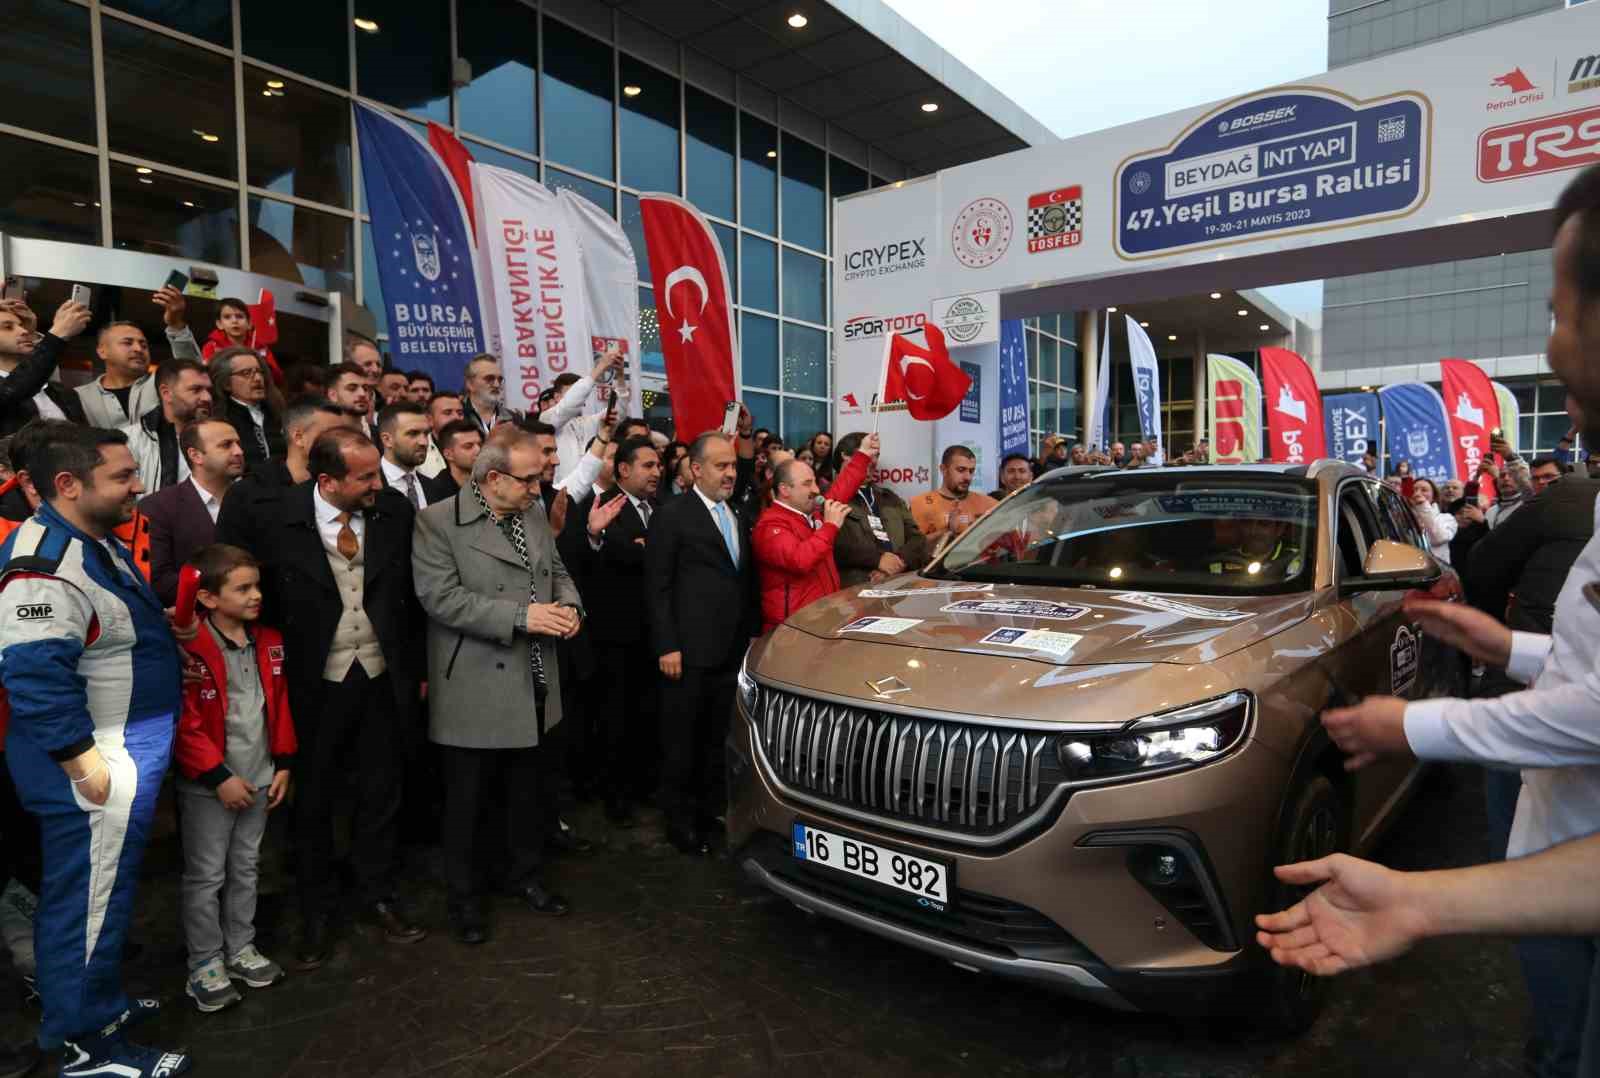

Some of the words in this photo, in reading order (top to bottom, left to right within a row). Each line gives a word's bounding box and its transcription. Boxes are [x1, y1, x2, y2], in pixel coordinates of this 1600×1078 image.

[1486, 96, 1516, 112] Petrol
[1230, 104, 1297, 129] BOSSEK
[1174, 155, 1252, 187] BEYDAĞ
[1263, 146, 1297, 169] INT
[1300, 136, 1346, 161] YAPI
[1229, 183, 1307, 214] Bursa
[1316, 158, 1411, 198] Rallisi
[1205, 219, 1249, 235] 19-20-21
[1251, 214, 1283, 229] MAYIS
[1286, 208, 1311, 221] 2023
[844, 238, 926, 271] ICRYPEX
[1030, 233, 1079, 252] TOSFED
[844, 268, 876, 281] CRYPTO
[879, 257, 926, 276] EXCHANGE
[394, 304, 473, 323] BURSA
[400, 337, 478, 353] BELEDİYESİ
[17, 605, 53, 618] OMP
[806, 830, 830, 862] 16
[843, 840, 879, 877] BB
[891, 855, 941, 897] 982
